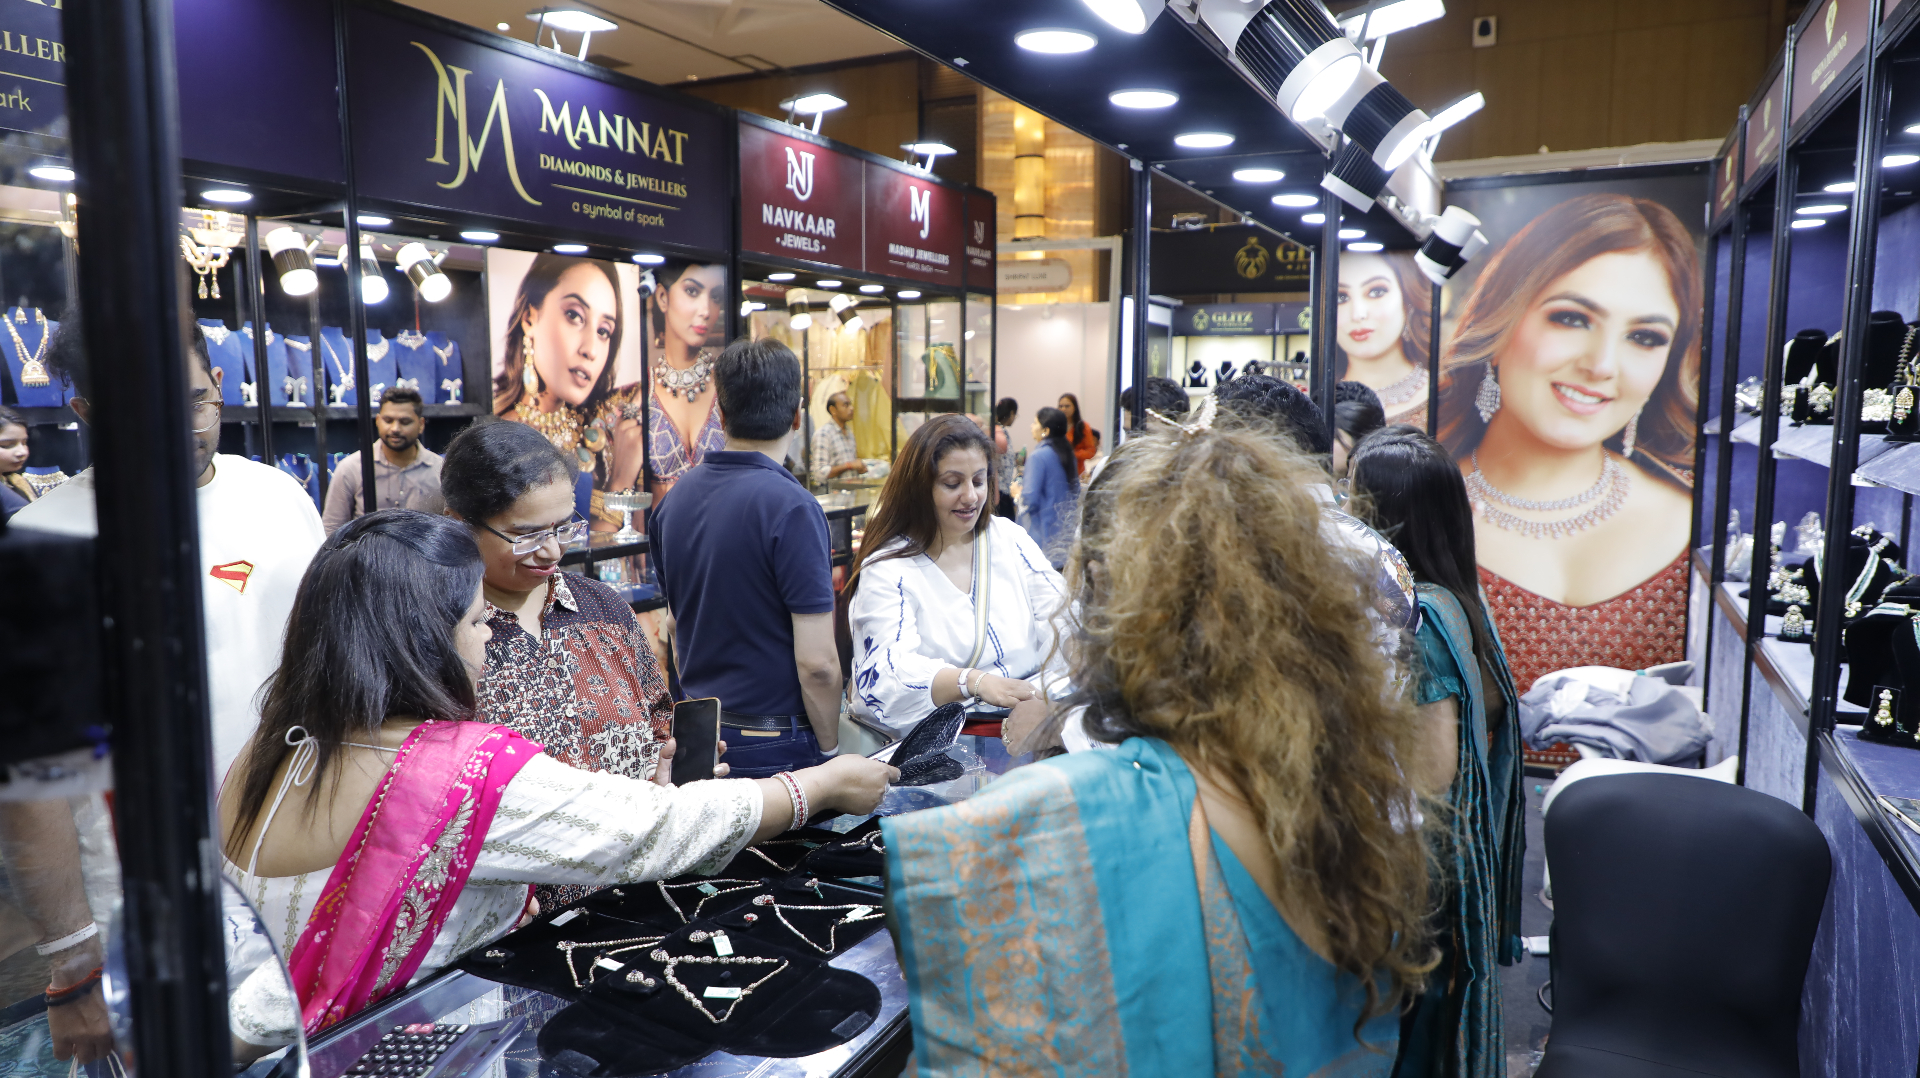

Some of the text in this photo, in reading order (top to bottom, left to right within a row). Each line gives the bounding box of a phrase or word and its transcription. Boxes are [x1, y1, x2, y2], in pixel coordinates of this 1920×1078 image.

[532, 88, 689, 166] MANNAT
[539, 152, 688, 198] DIAMONDS & JEWELLERS
[571, 201, 665, 227] a symbol of spark
[762, 203, 836, 239] NAVKAAR
[781, 232, 821, 253] JEWELS
[888, 242, 950, 266] MADHU JEWELLERS
